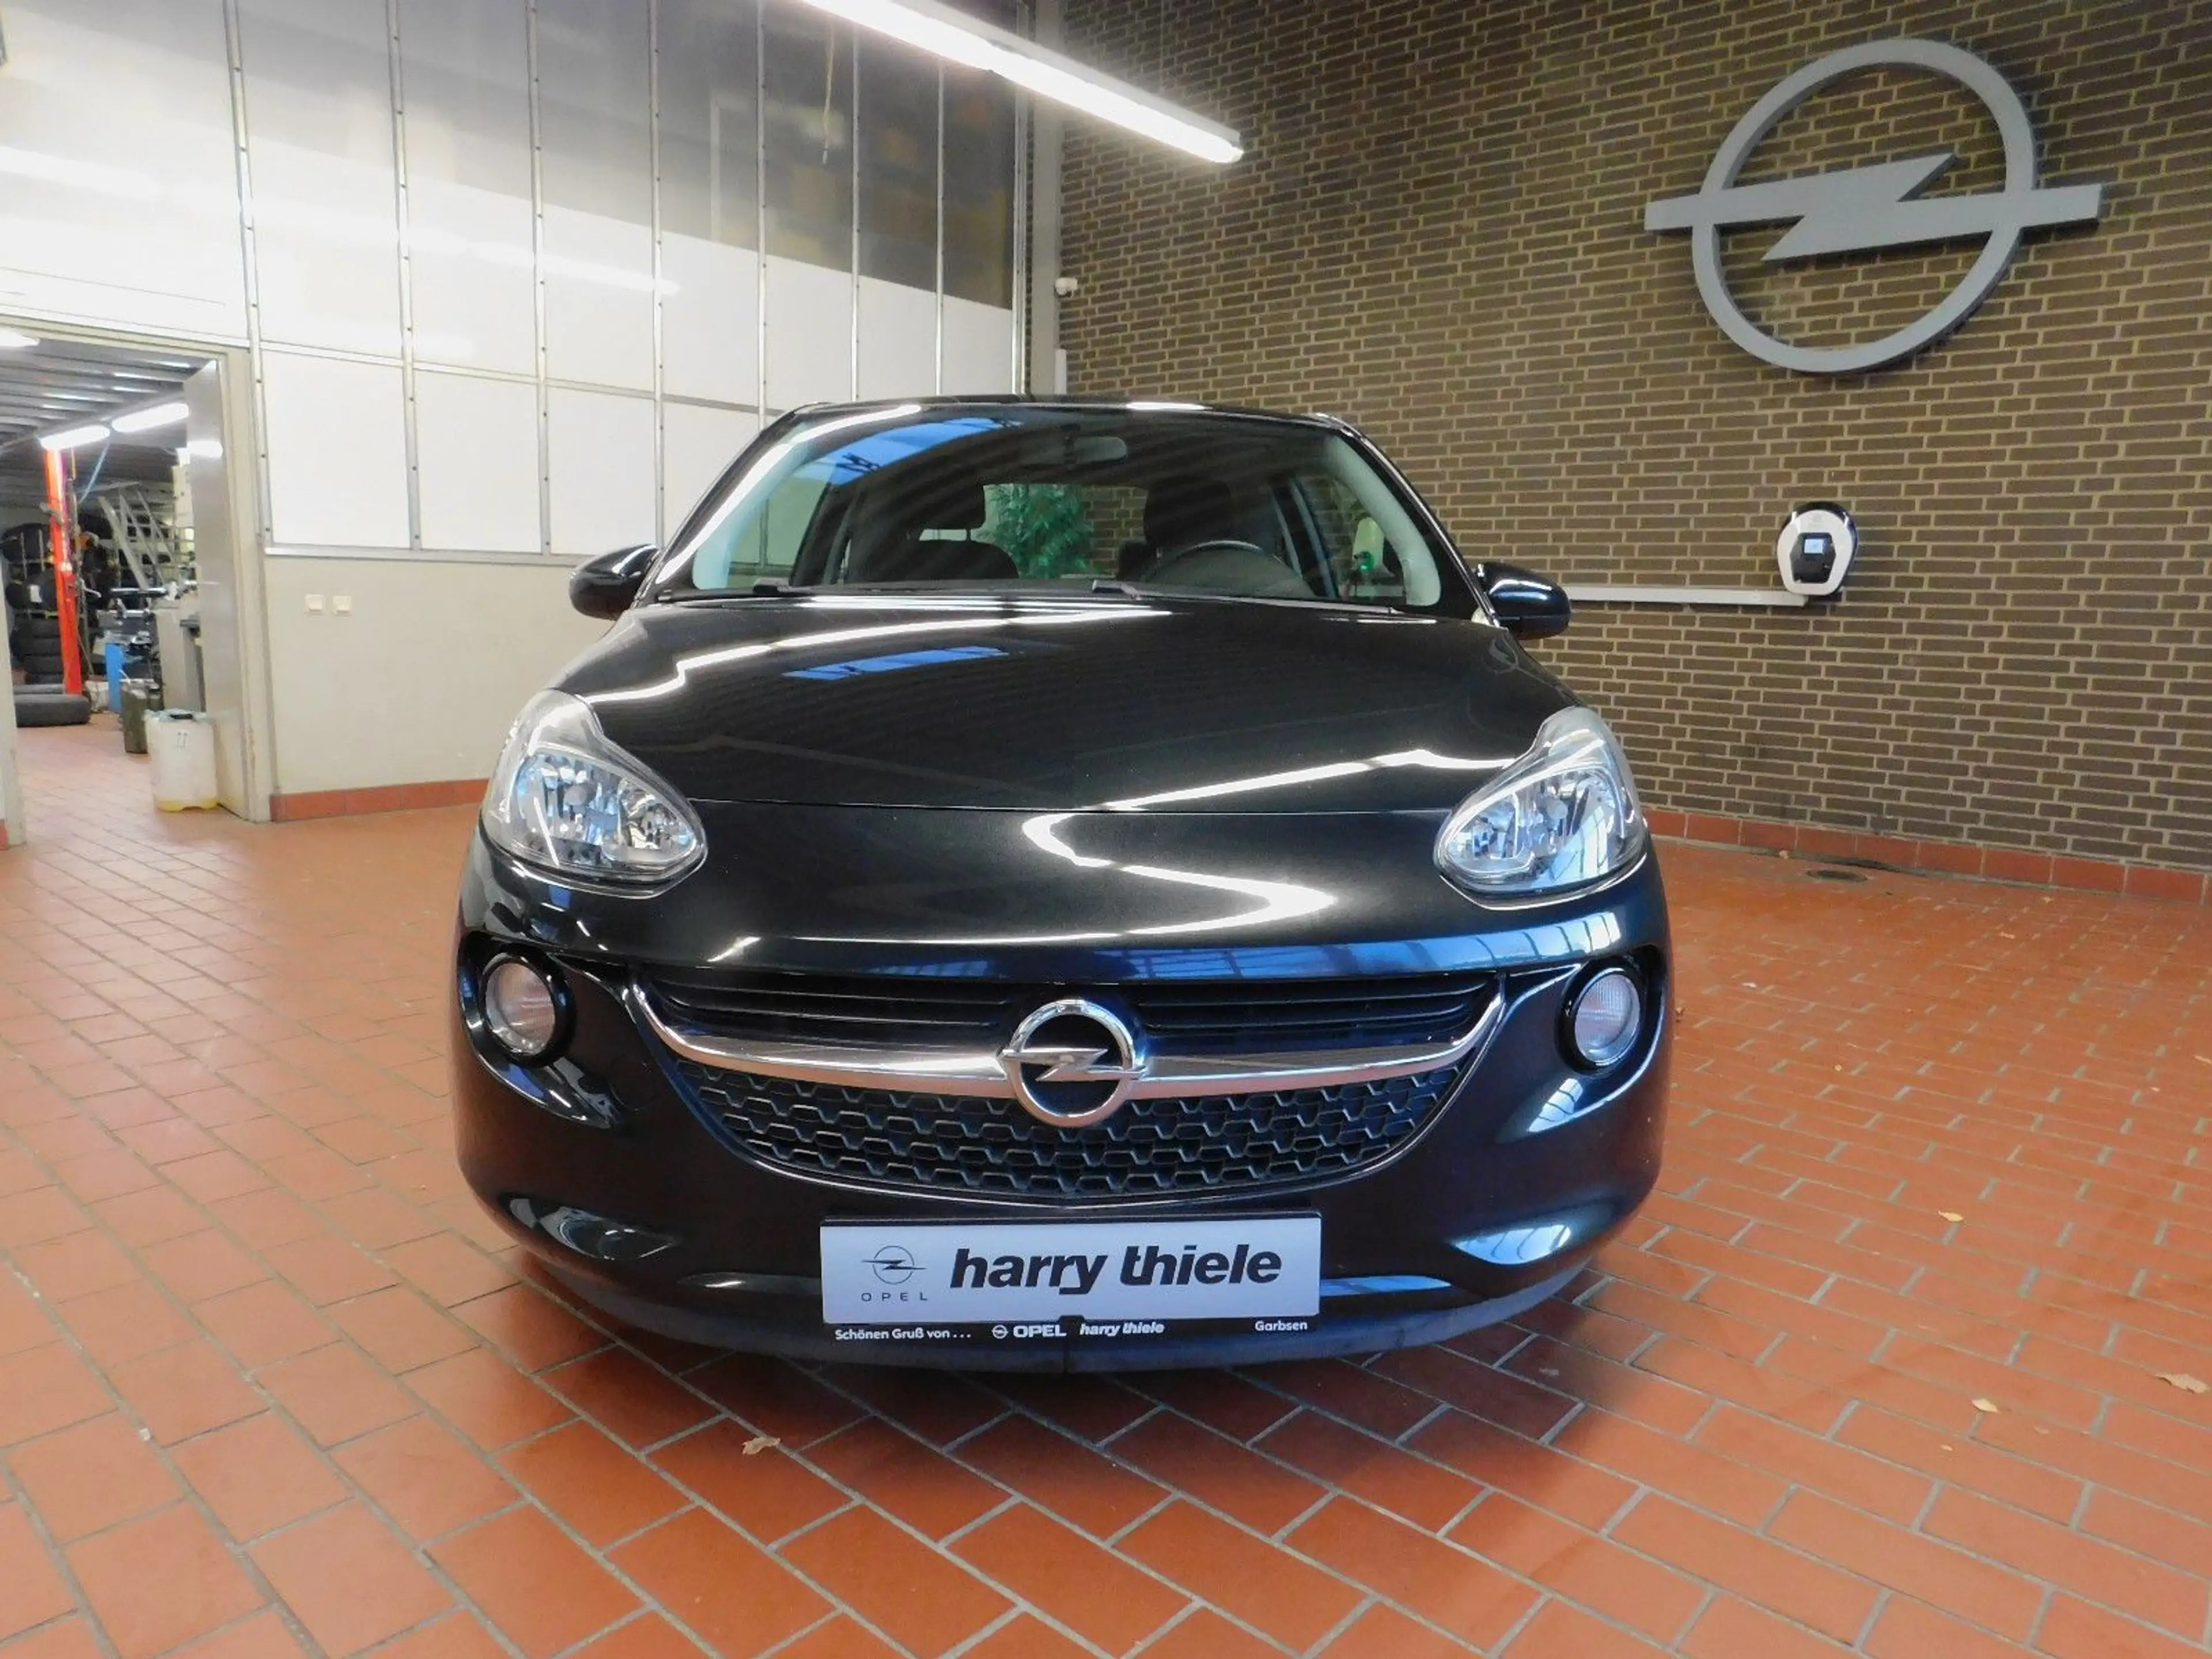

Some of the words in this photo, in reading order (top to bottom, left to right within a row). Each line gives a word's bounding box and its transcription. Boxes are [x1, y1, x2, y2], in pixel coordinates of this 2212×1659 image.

[949, 1248, 1108, 1296] harry
[1120, 1244, 1283, 1286] thiele
[861, 1291, 929, 1302] OPEL
[1013, 1324, 1067, 1338] OPEL
[1079, 1323, 1120, 1337] harry
[1123, 1321, 1165, 1335] thiele
[1255, 1320, 1308, 1331] Garbsen
[835, 1328, 889, 1340] Schönen
[892, 1327, 924, 1339] Gruß
[926, 1330, 950, 1339] von
